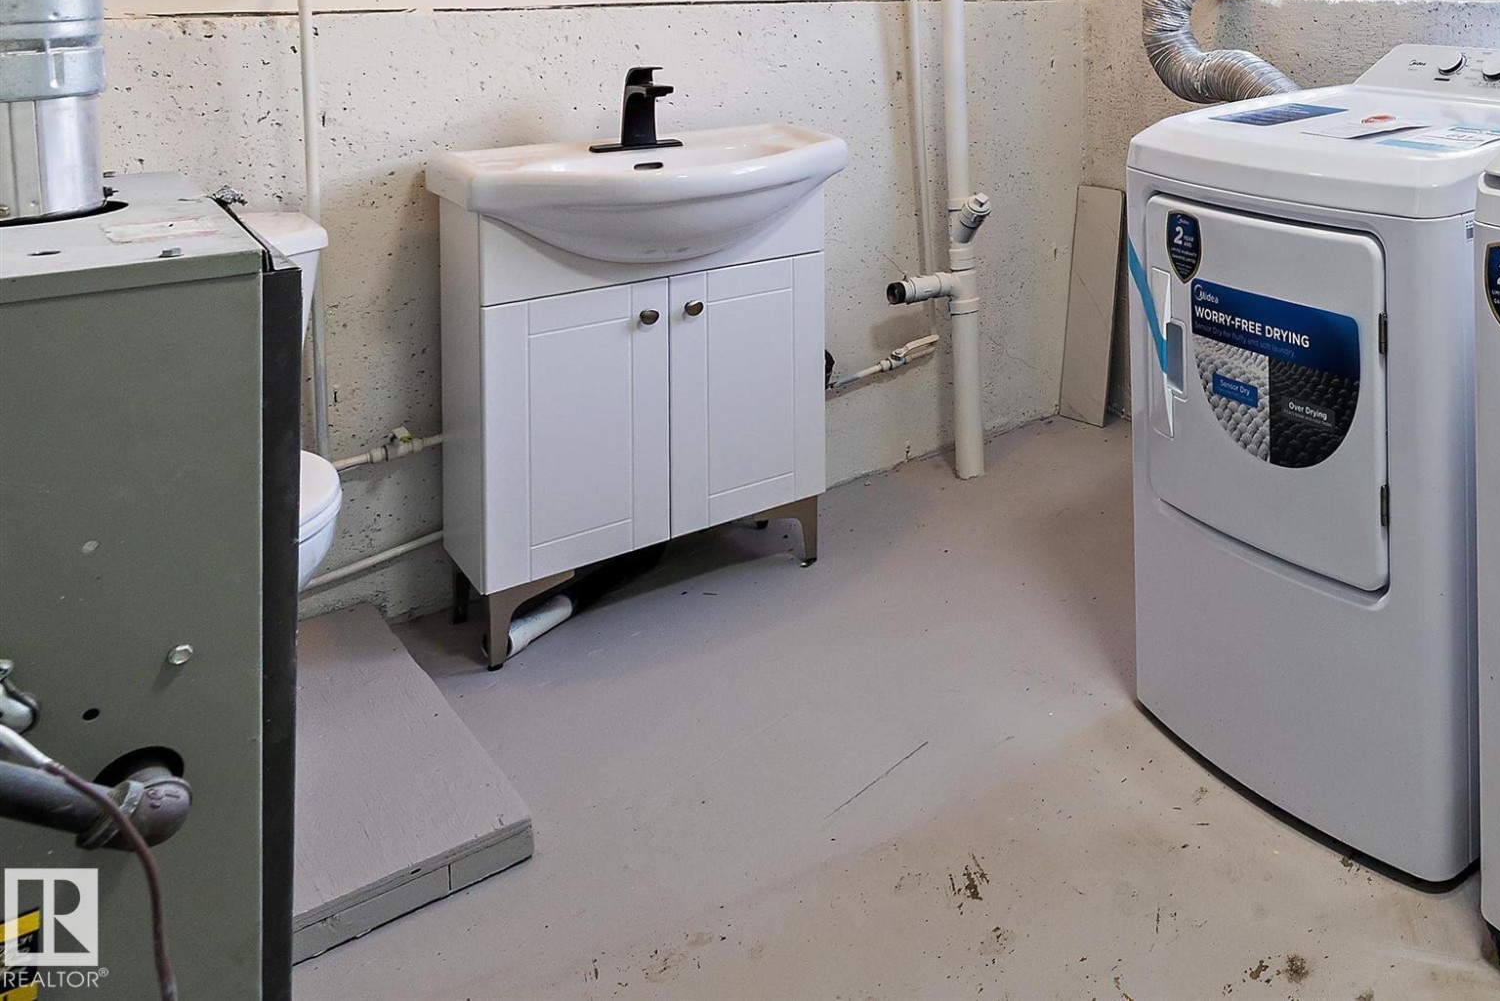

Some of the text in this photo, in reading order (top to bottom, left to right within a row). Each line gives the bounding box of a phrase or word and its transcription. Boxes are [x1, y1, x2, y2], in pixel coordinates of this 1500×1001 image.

[1174, 226, 1183, 245] 2
[1194, 284, 1219, 304] Midea
[1194, 305, 1310, 348] WORRY-FREE DRYING
[1195, 321, 1212, 332] Sensor
[1213, 326, 1223, 338] Dry
[1271, 345, 1295, 358] laundry
[1220, 379, 1239, 391] Sensor
[1239, 385, 1250, 397] Dry
[1288, 401, 1304, 412] Over
[1305, 406, 1328, 420] Drying
